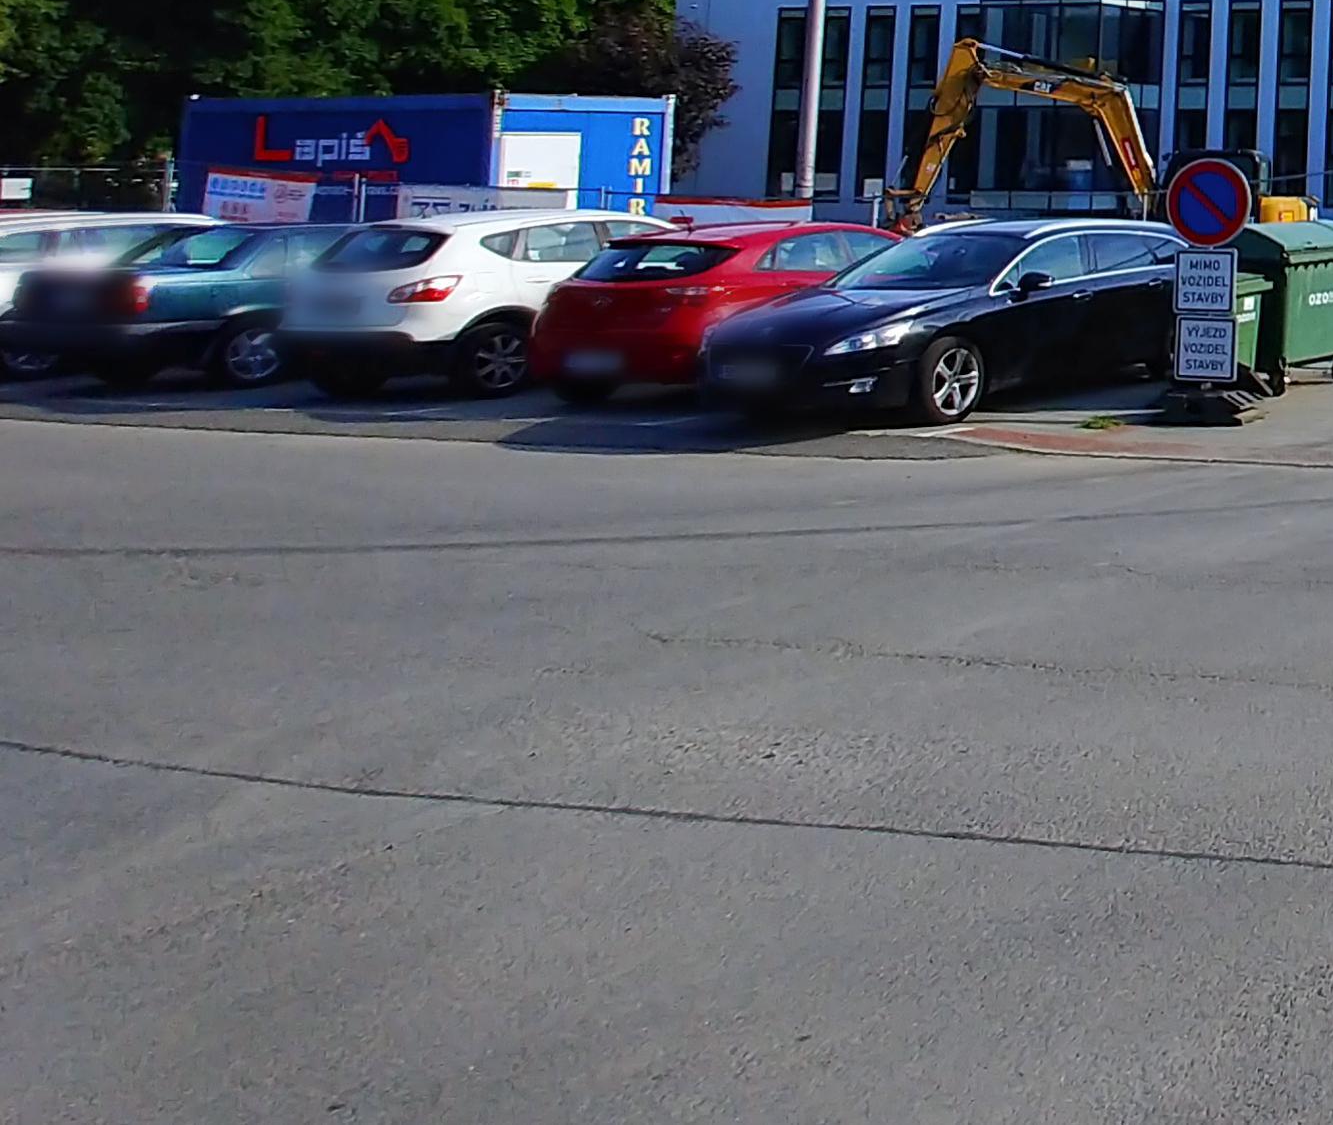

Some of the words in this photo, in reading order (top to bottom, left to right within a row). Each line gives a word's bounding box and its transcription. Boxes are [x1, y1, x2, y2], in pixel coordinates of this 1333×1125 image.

[1033, 81, 1052, 93] CAT
[1189, 260, 1221, 271] MIMO
[1181, 276, 1229, 288] VOZIDEL
[1183, 291, 1226, 304] STAVBY
[1187, 325, 1227, 339] VÝJEZD
[1183, 342, 1229, 355] VOZIDEL
[1185, 358, 1225, 371] STAVBY
